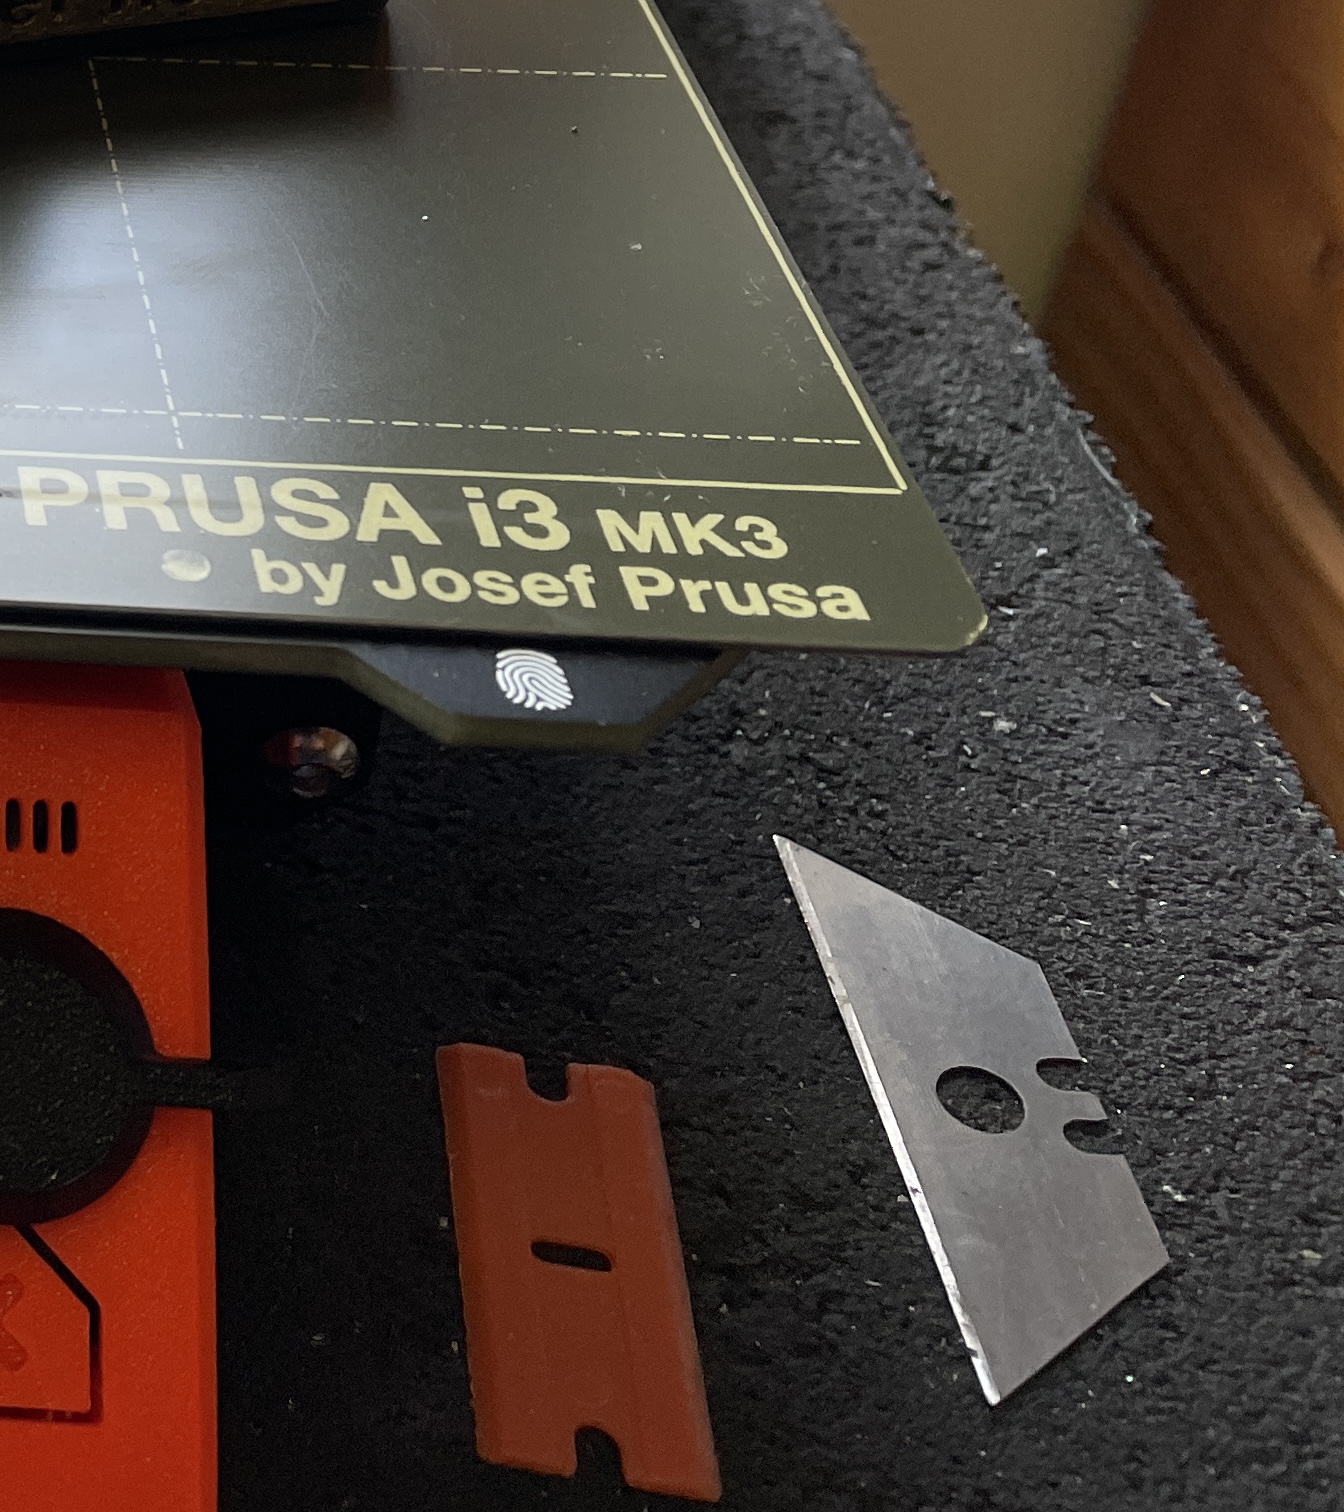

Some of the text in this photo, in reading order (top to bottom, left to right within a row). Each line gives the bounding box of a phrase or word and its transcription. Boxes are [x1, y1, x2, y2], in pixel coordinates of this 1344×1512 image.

[16, 464, 443, 546] PRUSA
[462, 485, 572, 551] i3
[595, 506, 790, 560] MK3
[251, 548, 872, 622] by Josef Prusa
